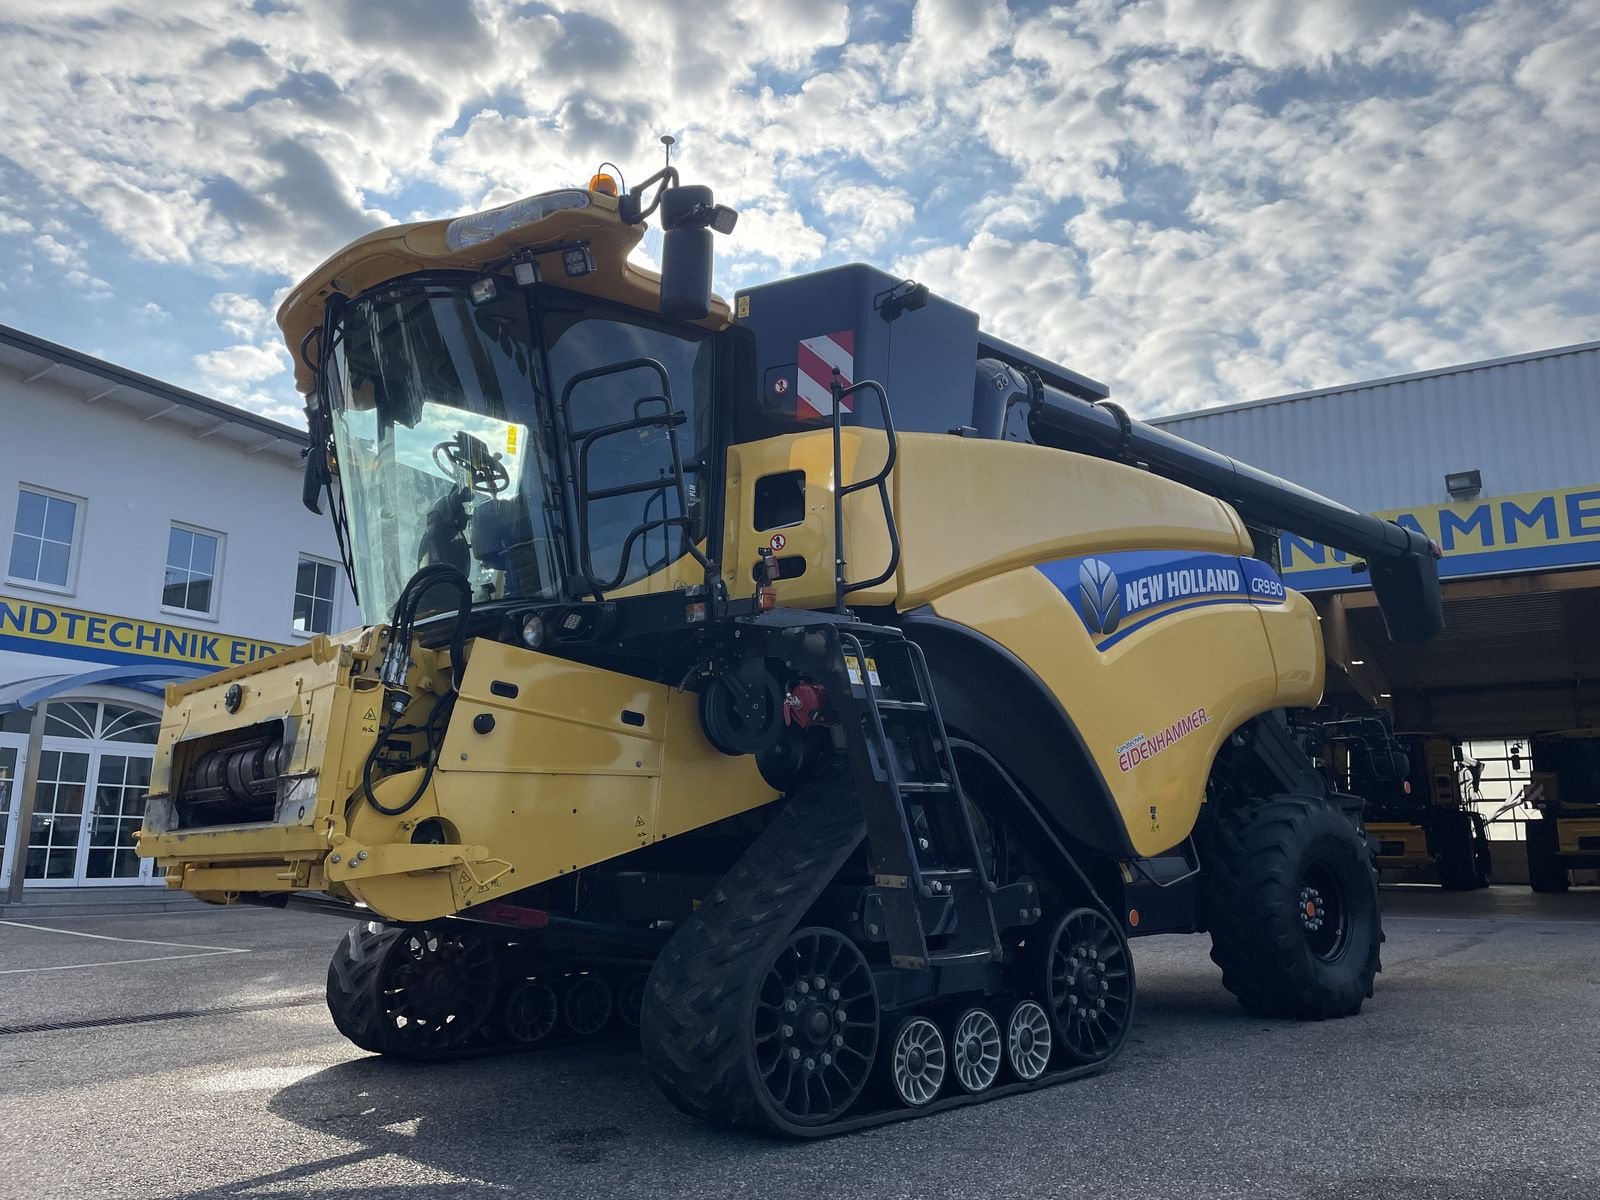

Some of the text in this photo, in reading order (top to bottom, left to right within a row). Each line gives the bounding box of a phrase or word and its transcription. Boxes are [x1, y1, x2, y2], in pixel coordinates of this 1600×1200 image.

[1125, 568, 1240, 612] NEW HOLLAND
[1251, 577, 1283, 596] CR9.90
[0, 601, 220, 662] NDTECHNIK
[1118, 707, 1208, 773] EIDENHAMMER
